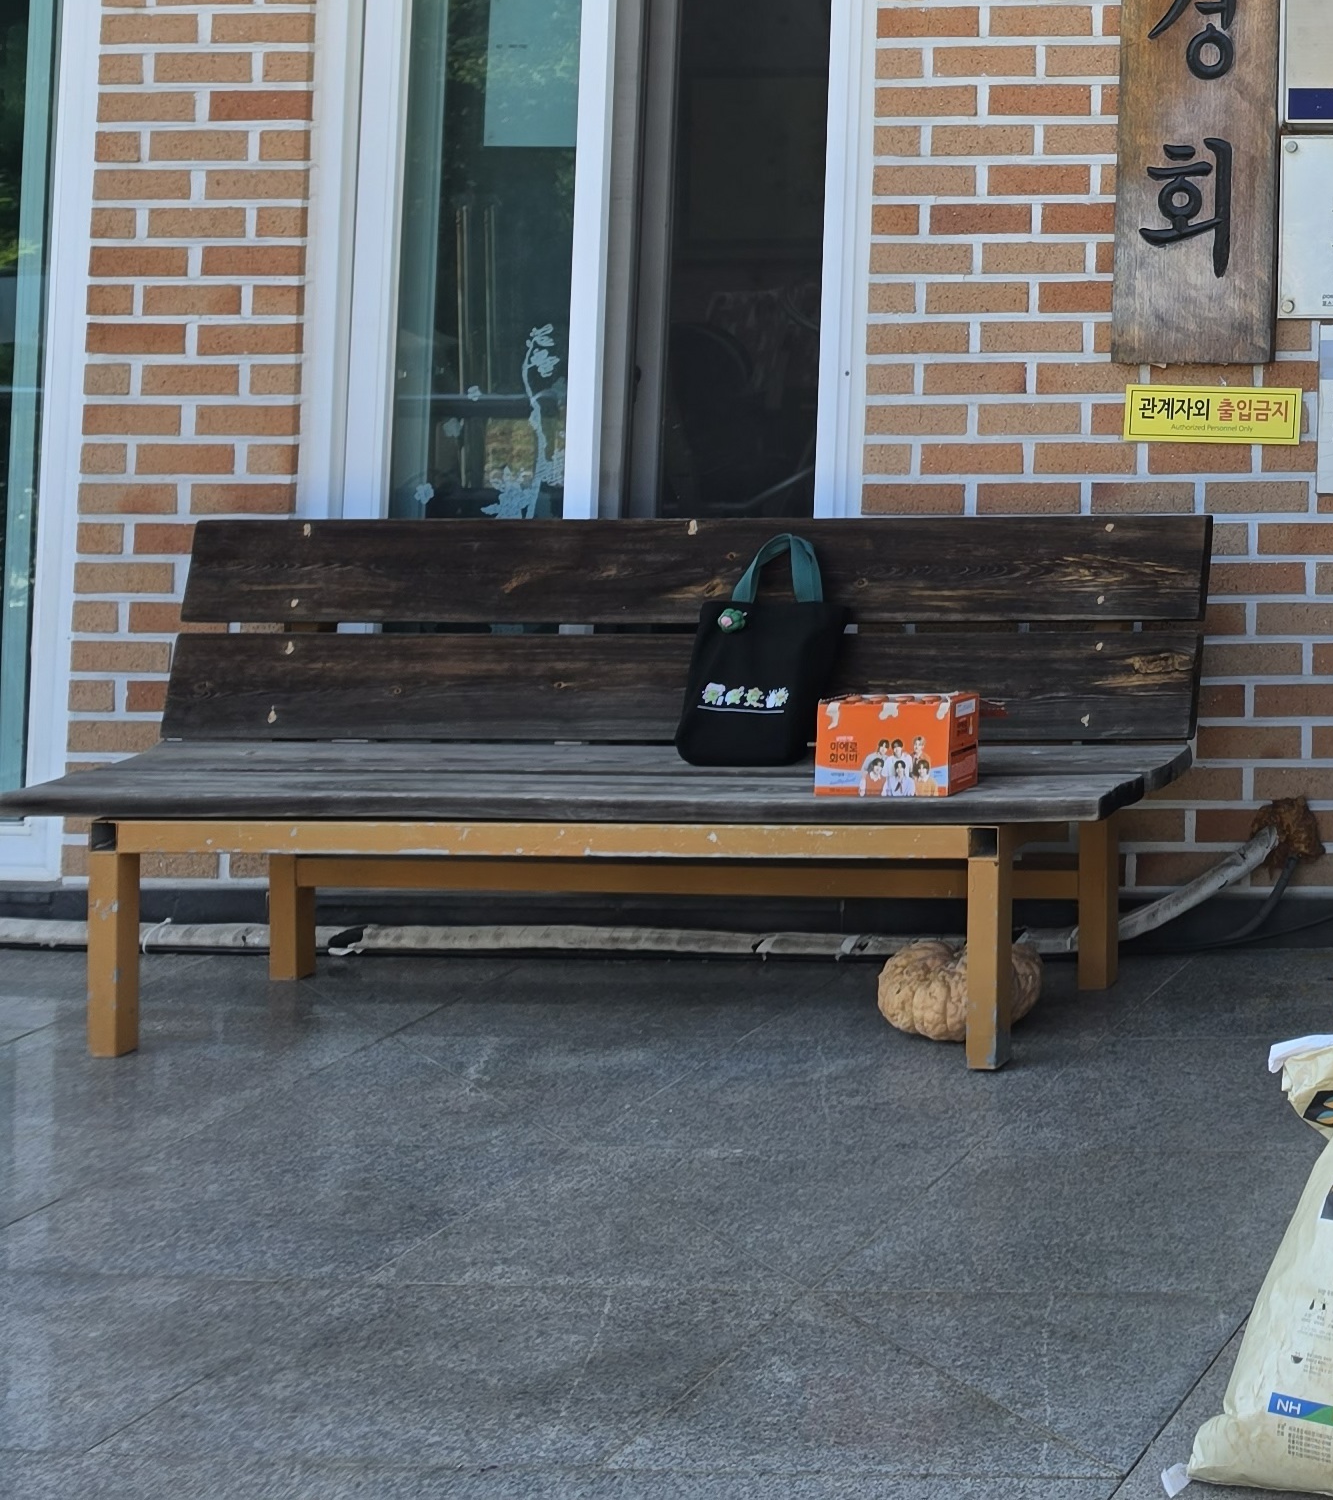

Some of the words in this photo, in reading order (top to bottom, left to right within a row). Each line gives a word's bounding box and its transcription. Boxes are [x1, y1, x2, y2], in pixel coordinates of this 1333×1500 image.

[1139, 397, 1210, 421] 관계자외
[1217, 398, 1289, 423] 출입금지
[1207, 424, 1237, 432] Personnel
[1276, 1398, 1301, 1415] NH
